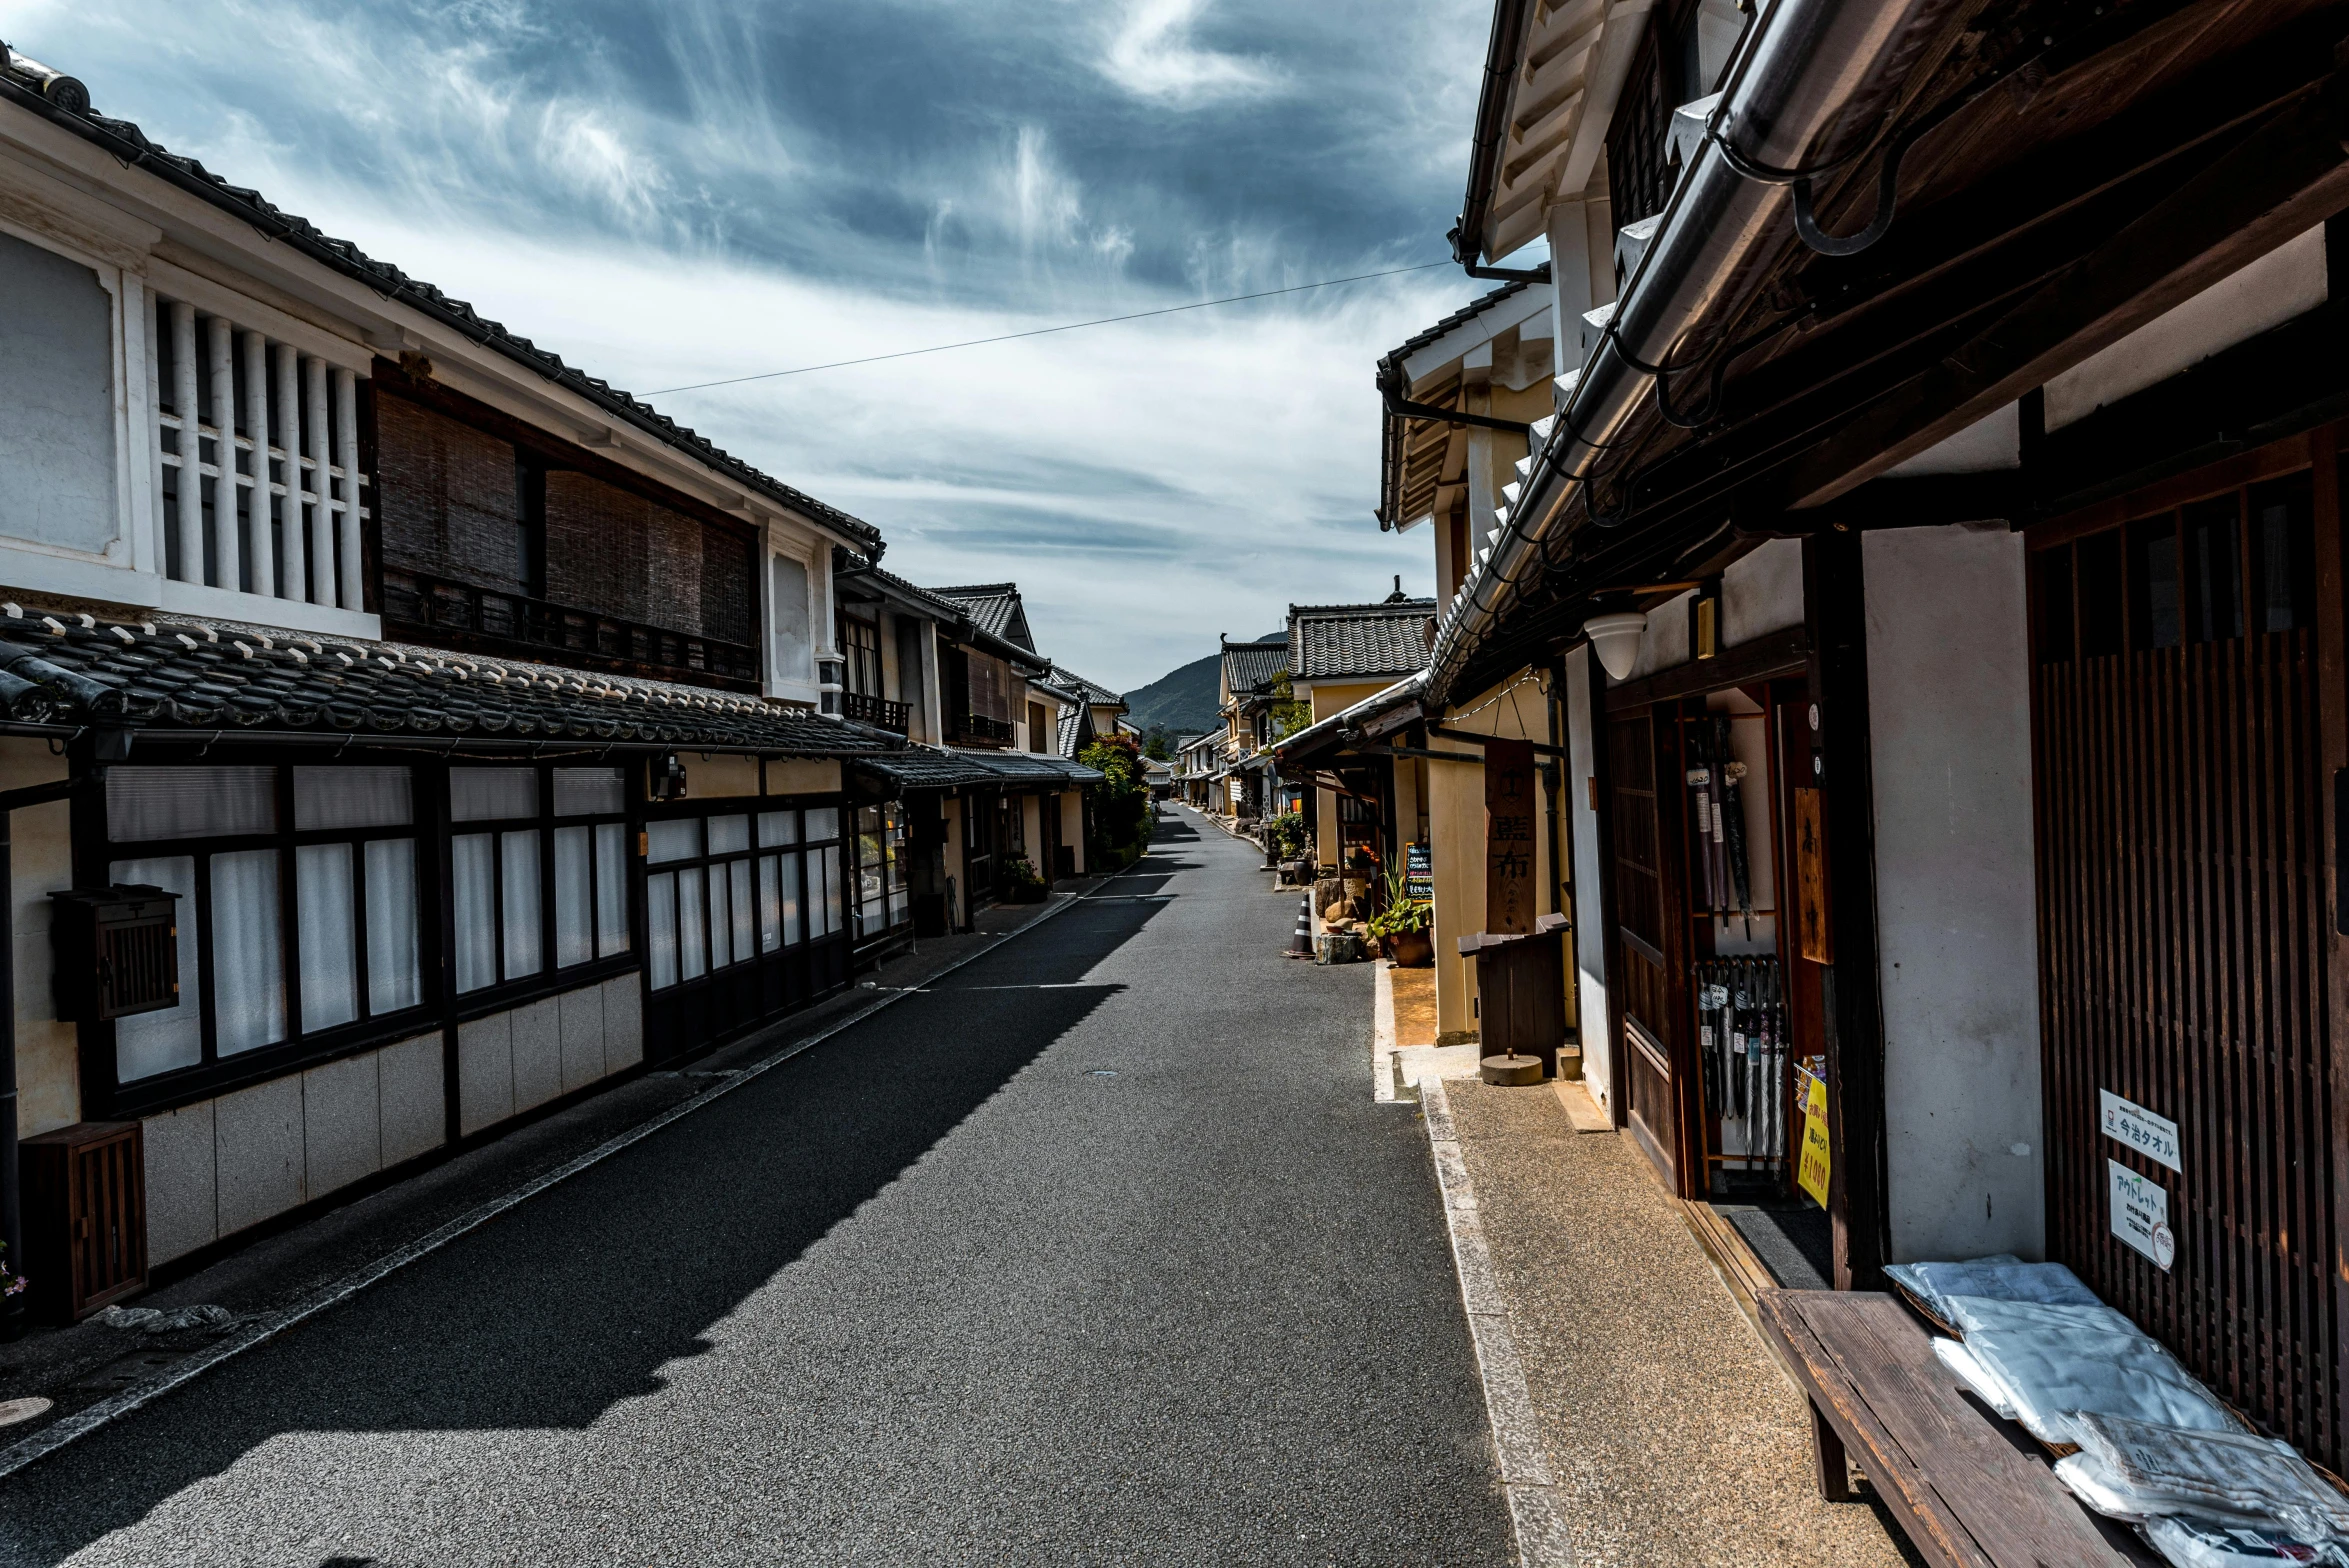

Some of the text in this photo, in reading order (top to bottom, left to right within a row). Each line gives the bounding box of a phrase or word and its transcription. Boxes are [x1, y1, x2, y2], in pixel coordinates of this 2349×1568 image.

[1492, 816, 1531, 879] 藍布
[2120, 1118, 2174, 1157] 今治タオル
[2117, 1175, 2157, 1211] アウトレット
